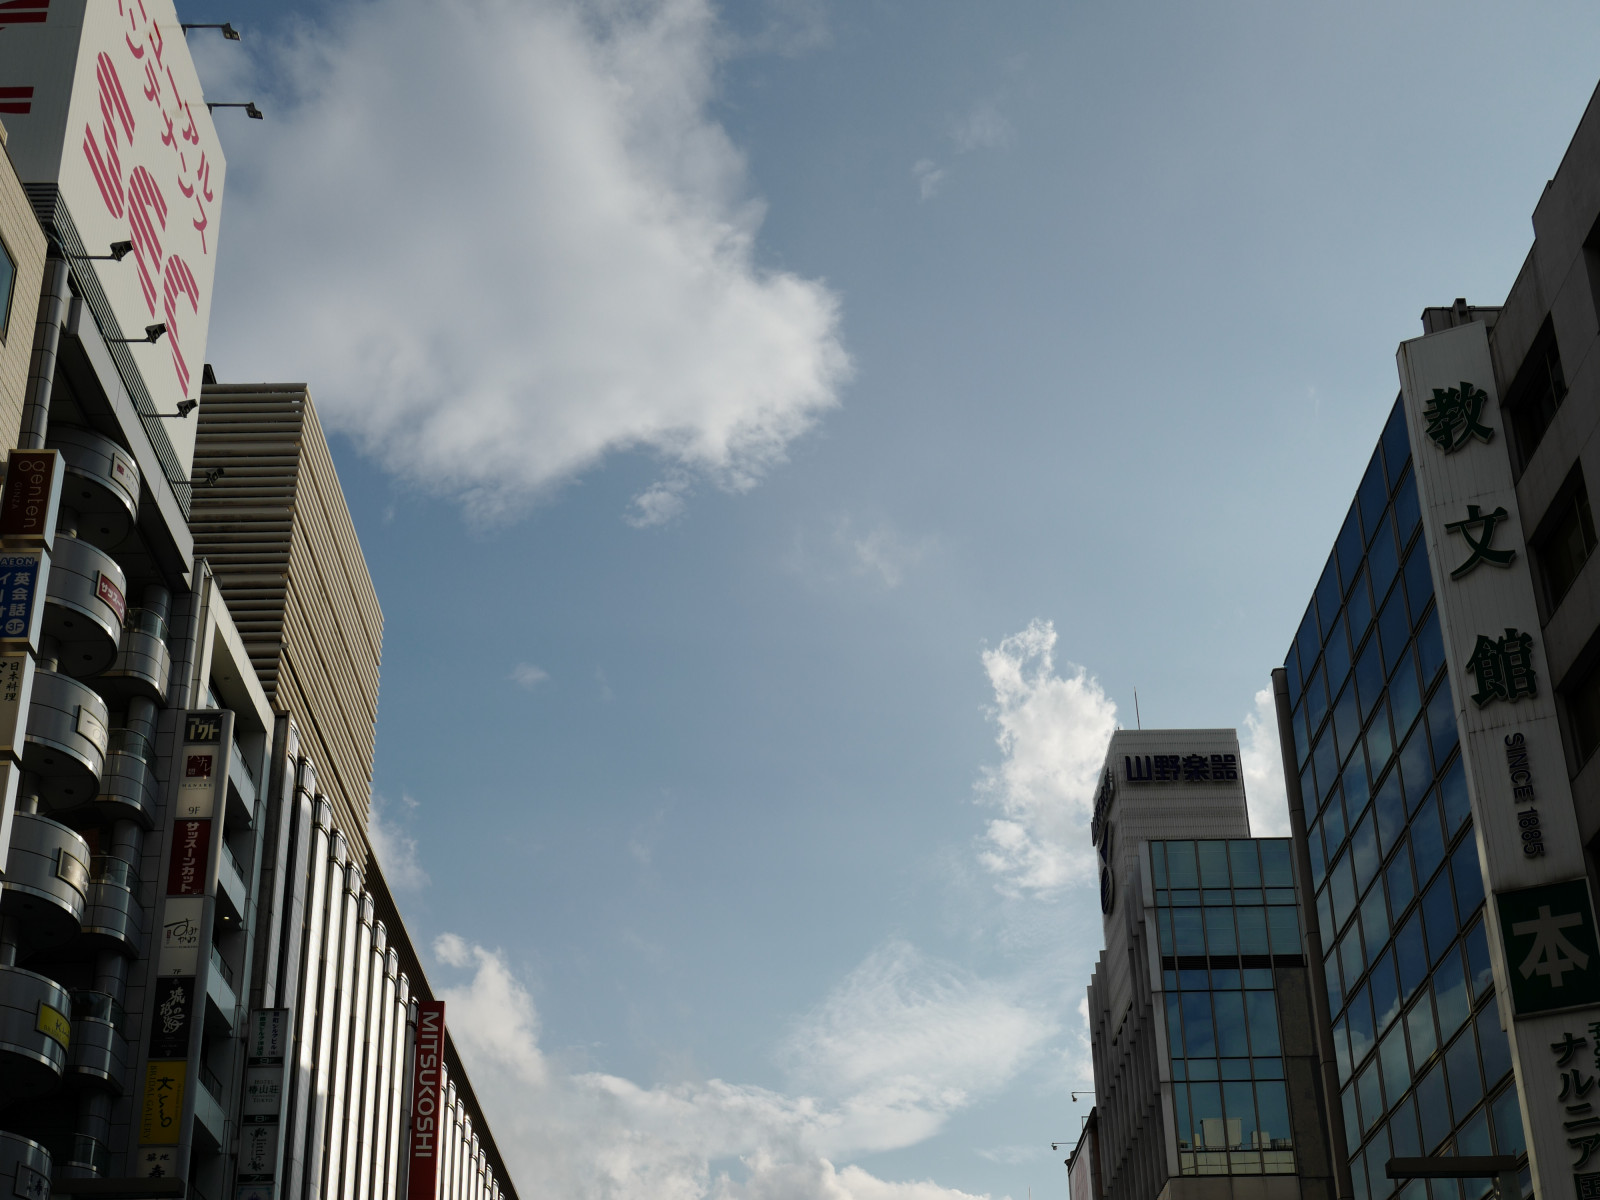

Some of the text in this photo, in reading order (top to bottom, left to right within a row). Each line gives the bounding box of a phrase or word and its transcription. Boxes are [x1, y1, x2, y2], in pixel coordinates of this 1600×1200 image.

[12, 481, 23, 509] GINZA
[24, 460, 46, 529] genten
[1423, 381, 1539, 706] 教文館
[8, 572, 31, 617] 英会話
[4, 661, 19, 701] 日本料理
[1125, 754, 1238, 780] 山野楽器
[1504, 732, 1546, 856] SINCE 1885
[188, 806, 200, 814] 9F
[180, 821, 200, 893] サッスーンカット
[1512, 904, 1589, 988] 本
[143, 1065, 159, 1140] BRIDAL GALLERY
[415, 1010, 441, 1159] MITSUKOSHI
